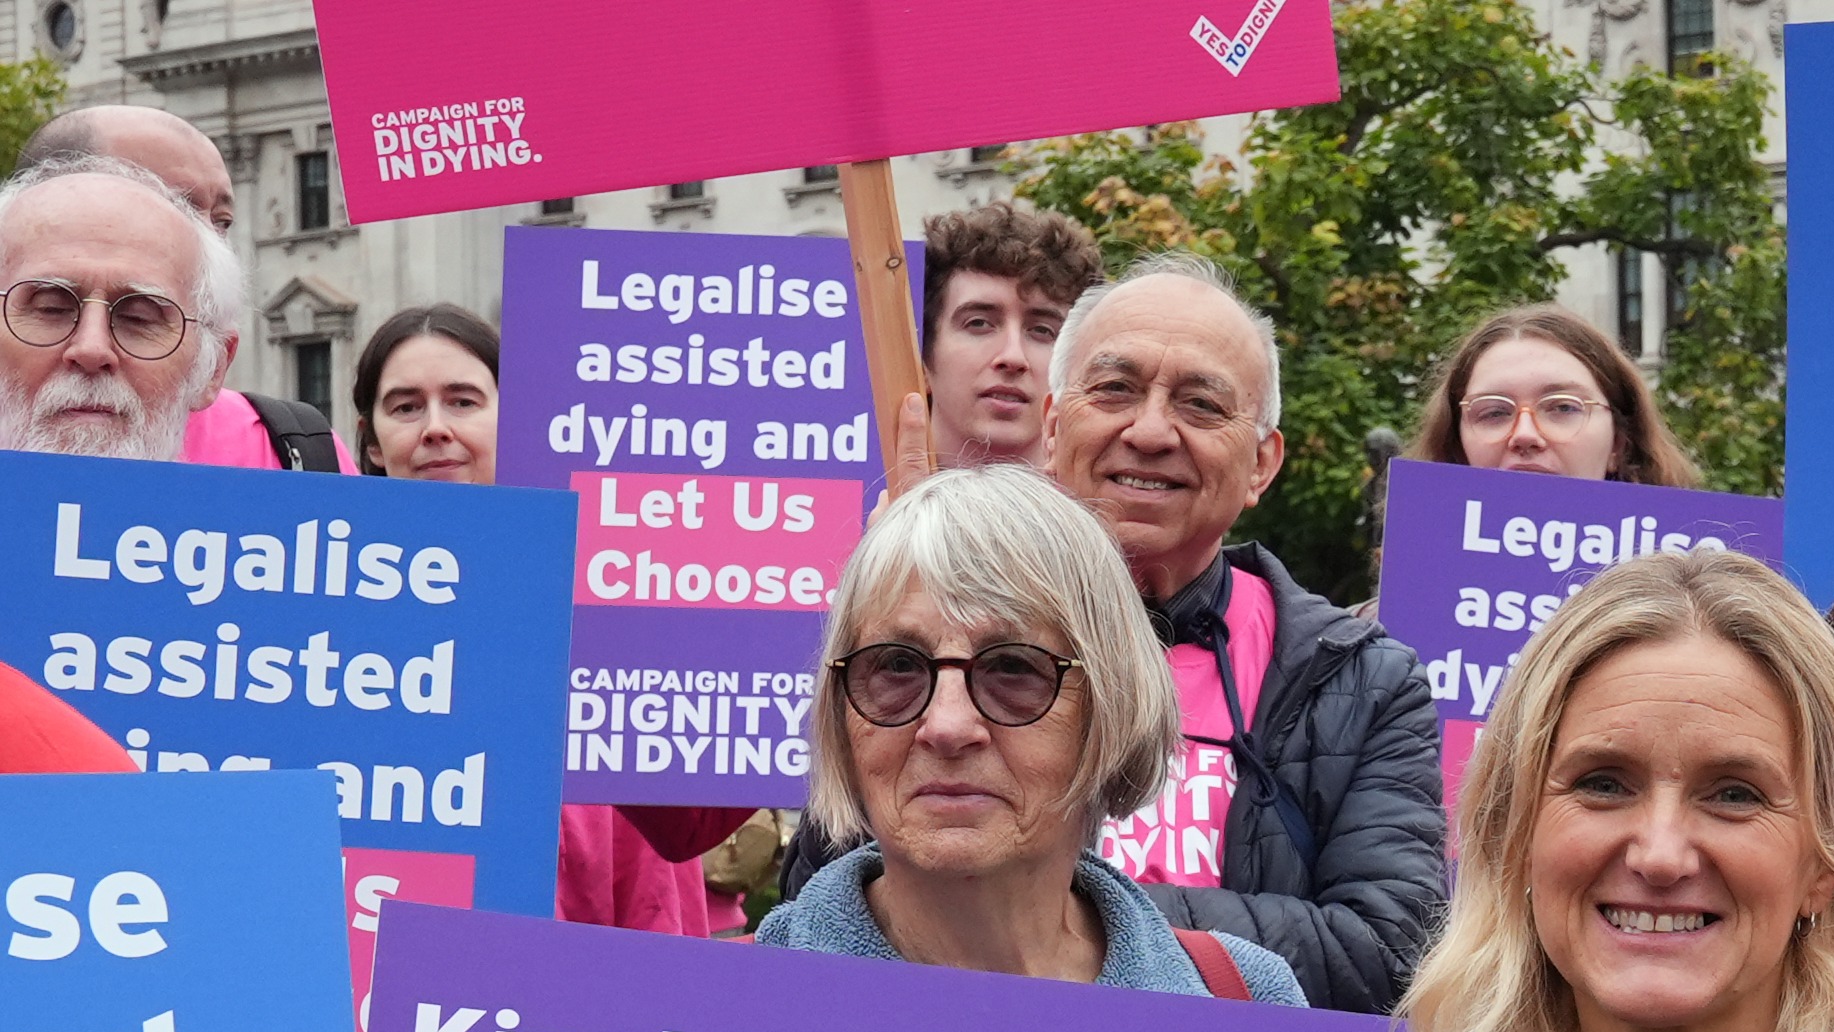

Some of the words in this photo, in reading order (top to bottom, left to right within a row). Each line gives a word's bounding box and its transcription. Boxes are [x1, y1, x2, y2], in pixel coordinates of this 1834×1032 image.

[1198, 21, 1229, 57] YES
[371, 102, 479, 128] CAMPAIGN
[484, 96, 525, 115] FOR
[373, 112, 526, 156] DIGNITY
[377, 153, 416, 182] IN
[421, 139, 543, 177] DYING.
[581, 260, 848, 325] Legalise
[576, 333, 846, 390] assisted
[548, 402, 728, 470] dying
[753, 412, 869, 463] and
[599, 477, 705, 530] Let
[732, 481, 815, 533] Us
[54, 501, 460, 606] Legalise
[43, 622, 455, 715] assisted
[570, 667, 740, 693] CAMPAIGN
[752, 672, 815, 696] FOR
[568, 691, 814, 736] DIGNITY
[566, 733, 624, 772] IN
